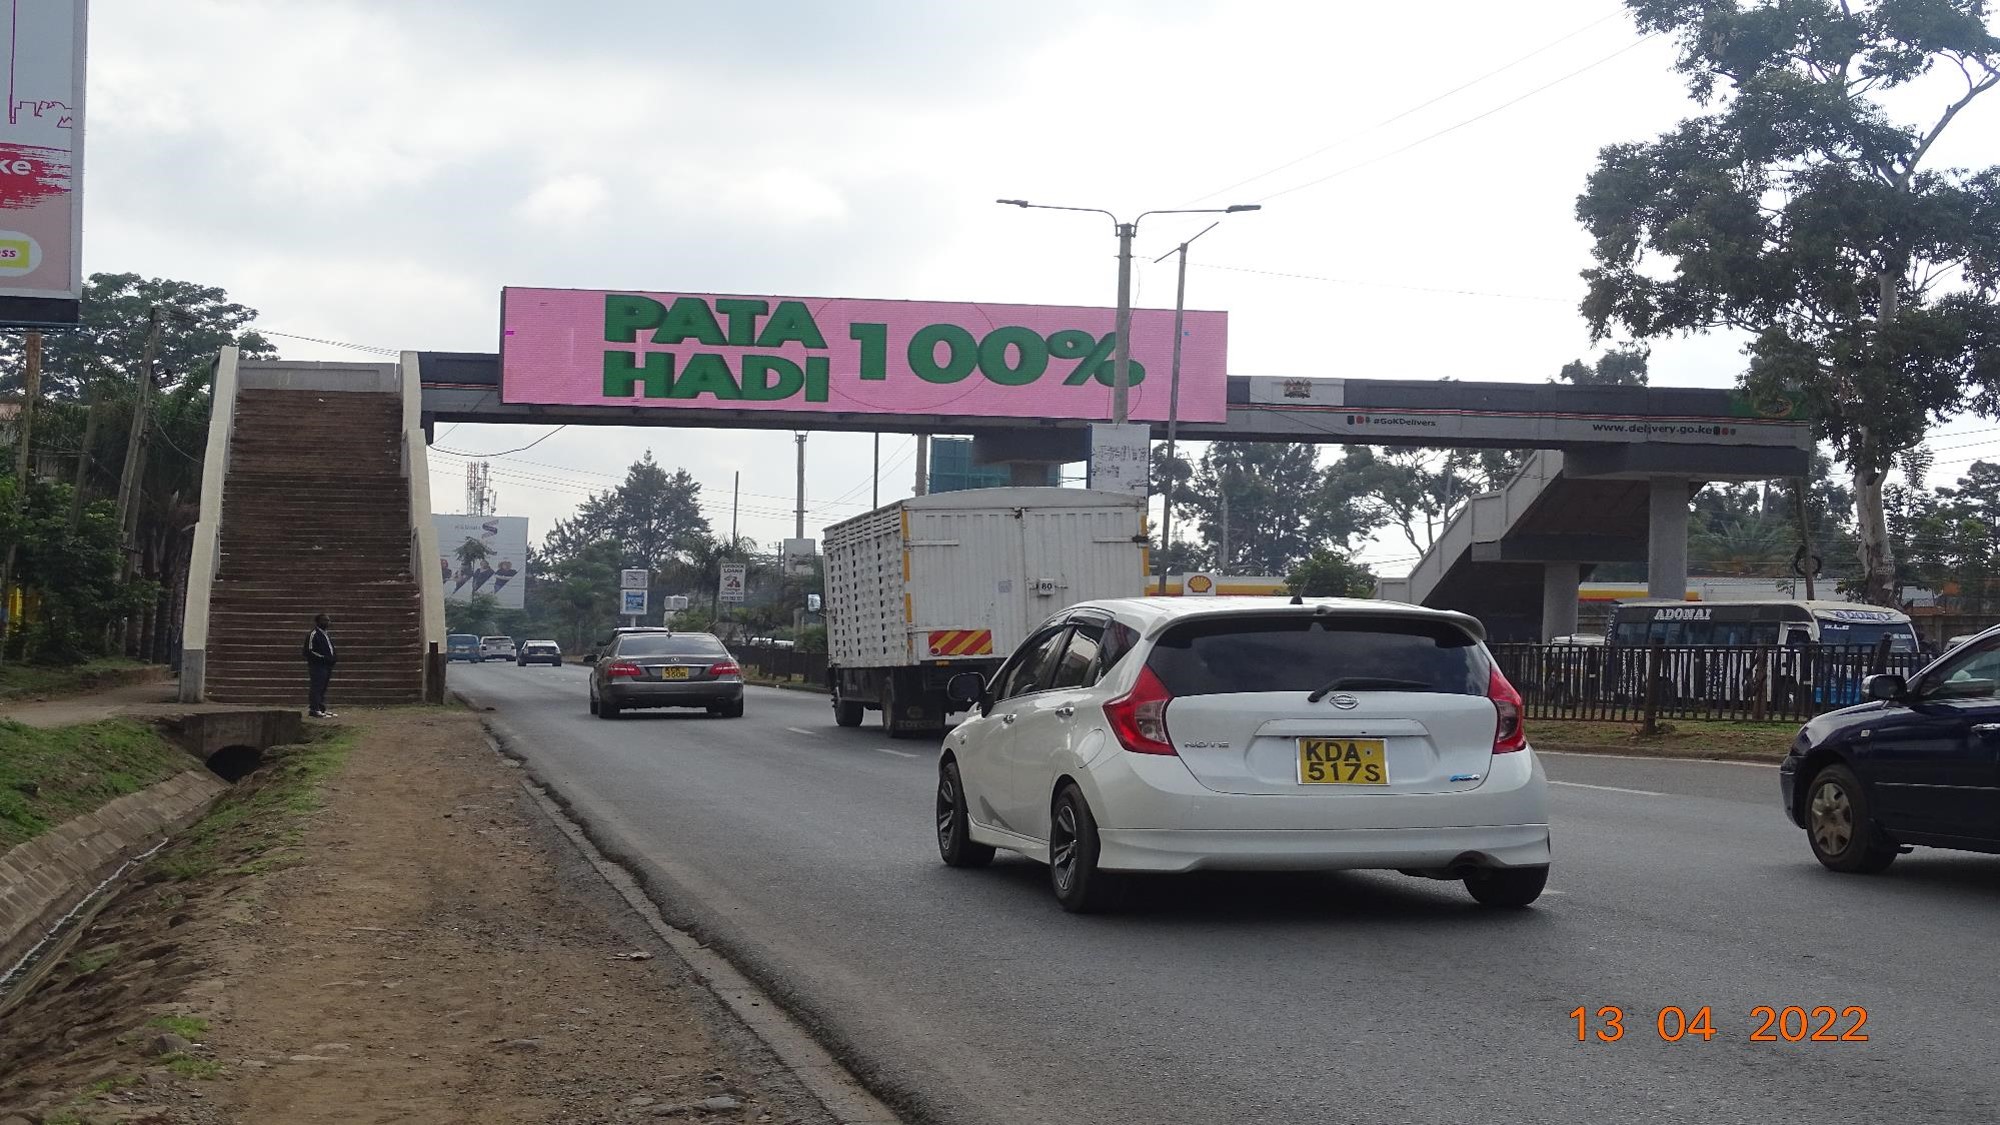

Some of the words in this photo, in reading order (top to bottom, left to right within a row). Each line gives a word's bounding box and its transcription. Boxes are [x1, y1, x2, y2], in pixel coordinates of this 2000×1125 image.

[0, 249, 16, 258] ss
[604, 294, 828, 349] PATA
[849, 323, 1146, 387] 100%
[603, 350, 830, 402] HADI
[1373, 417, 1436, 427] #GoKDelivers
[1592, 423, 1713, 435] www.delivery.go.ke
[1654, 608, 1712, 620] ADONAI
[1305, 741, 1361, 763] KDA
[1307, 762, 1381, 782] 517S
